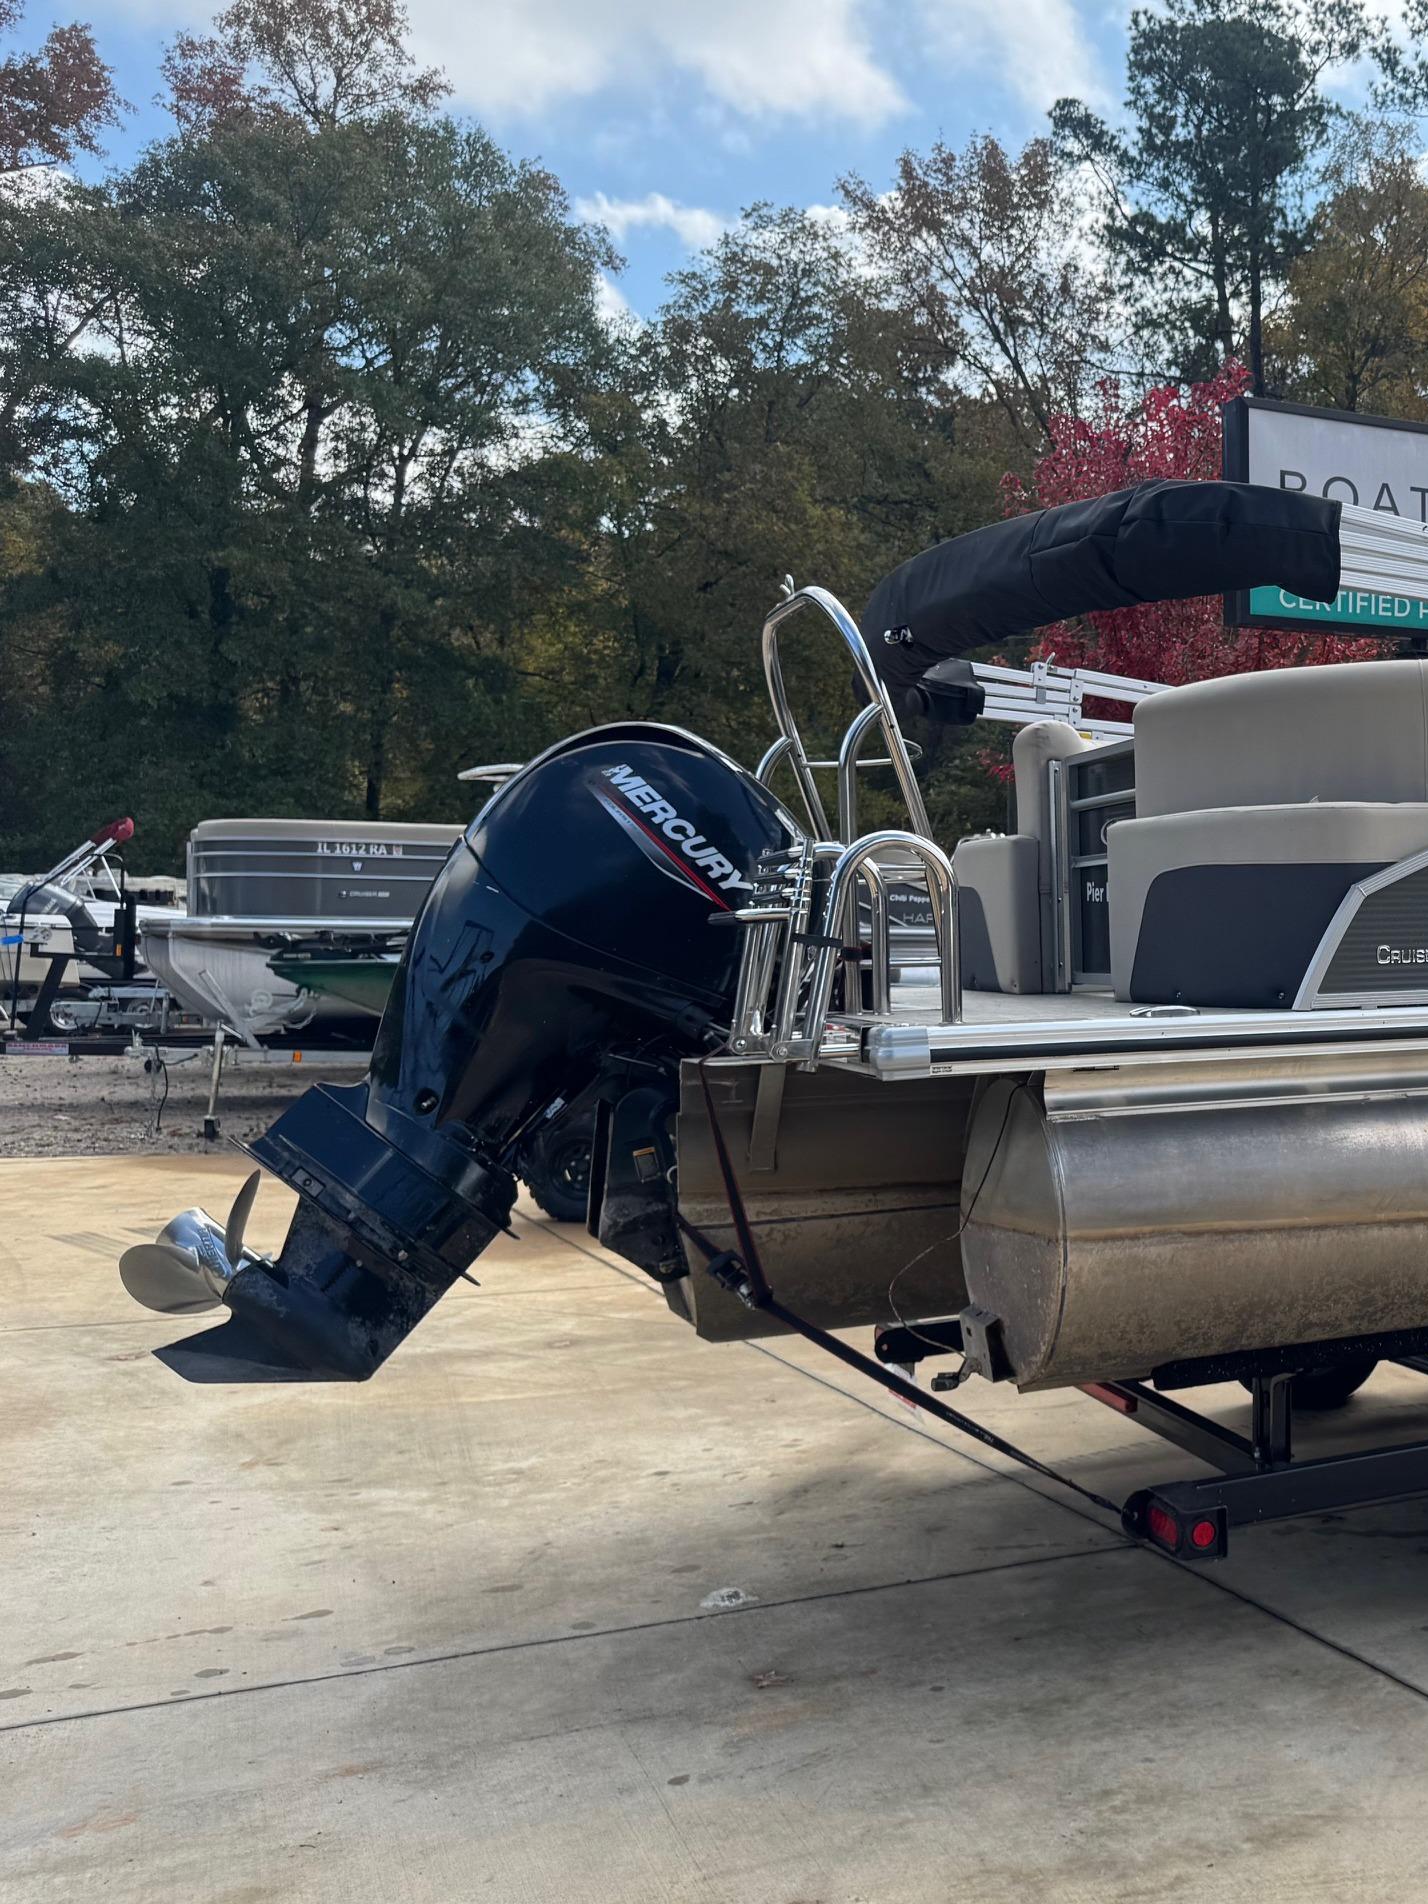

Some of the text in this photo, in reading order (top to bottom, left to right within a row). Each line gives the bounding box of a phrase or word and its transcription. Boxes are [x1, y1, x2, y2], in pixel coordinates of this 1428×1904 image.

[602, 763, 753, 890] MERCURY
[317, 842, 331, 854] IL
[335, 842, 366, 856] 1612
[370, 844, 387, 855] RA
[1086, 881, 1105, 902] Pier
